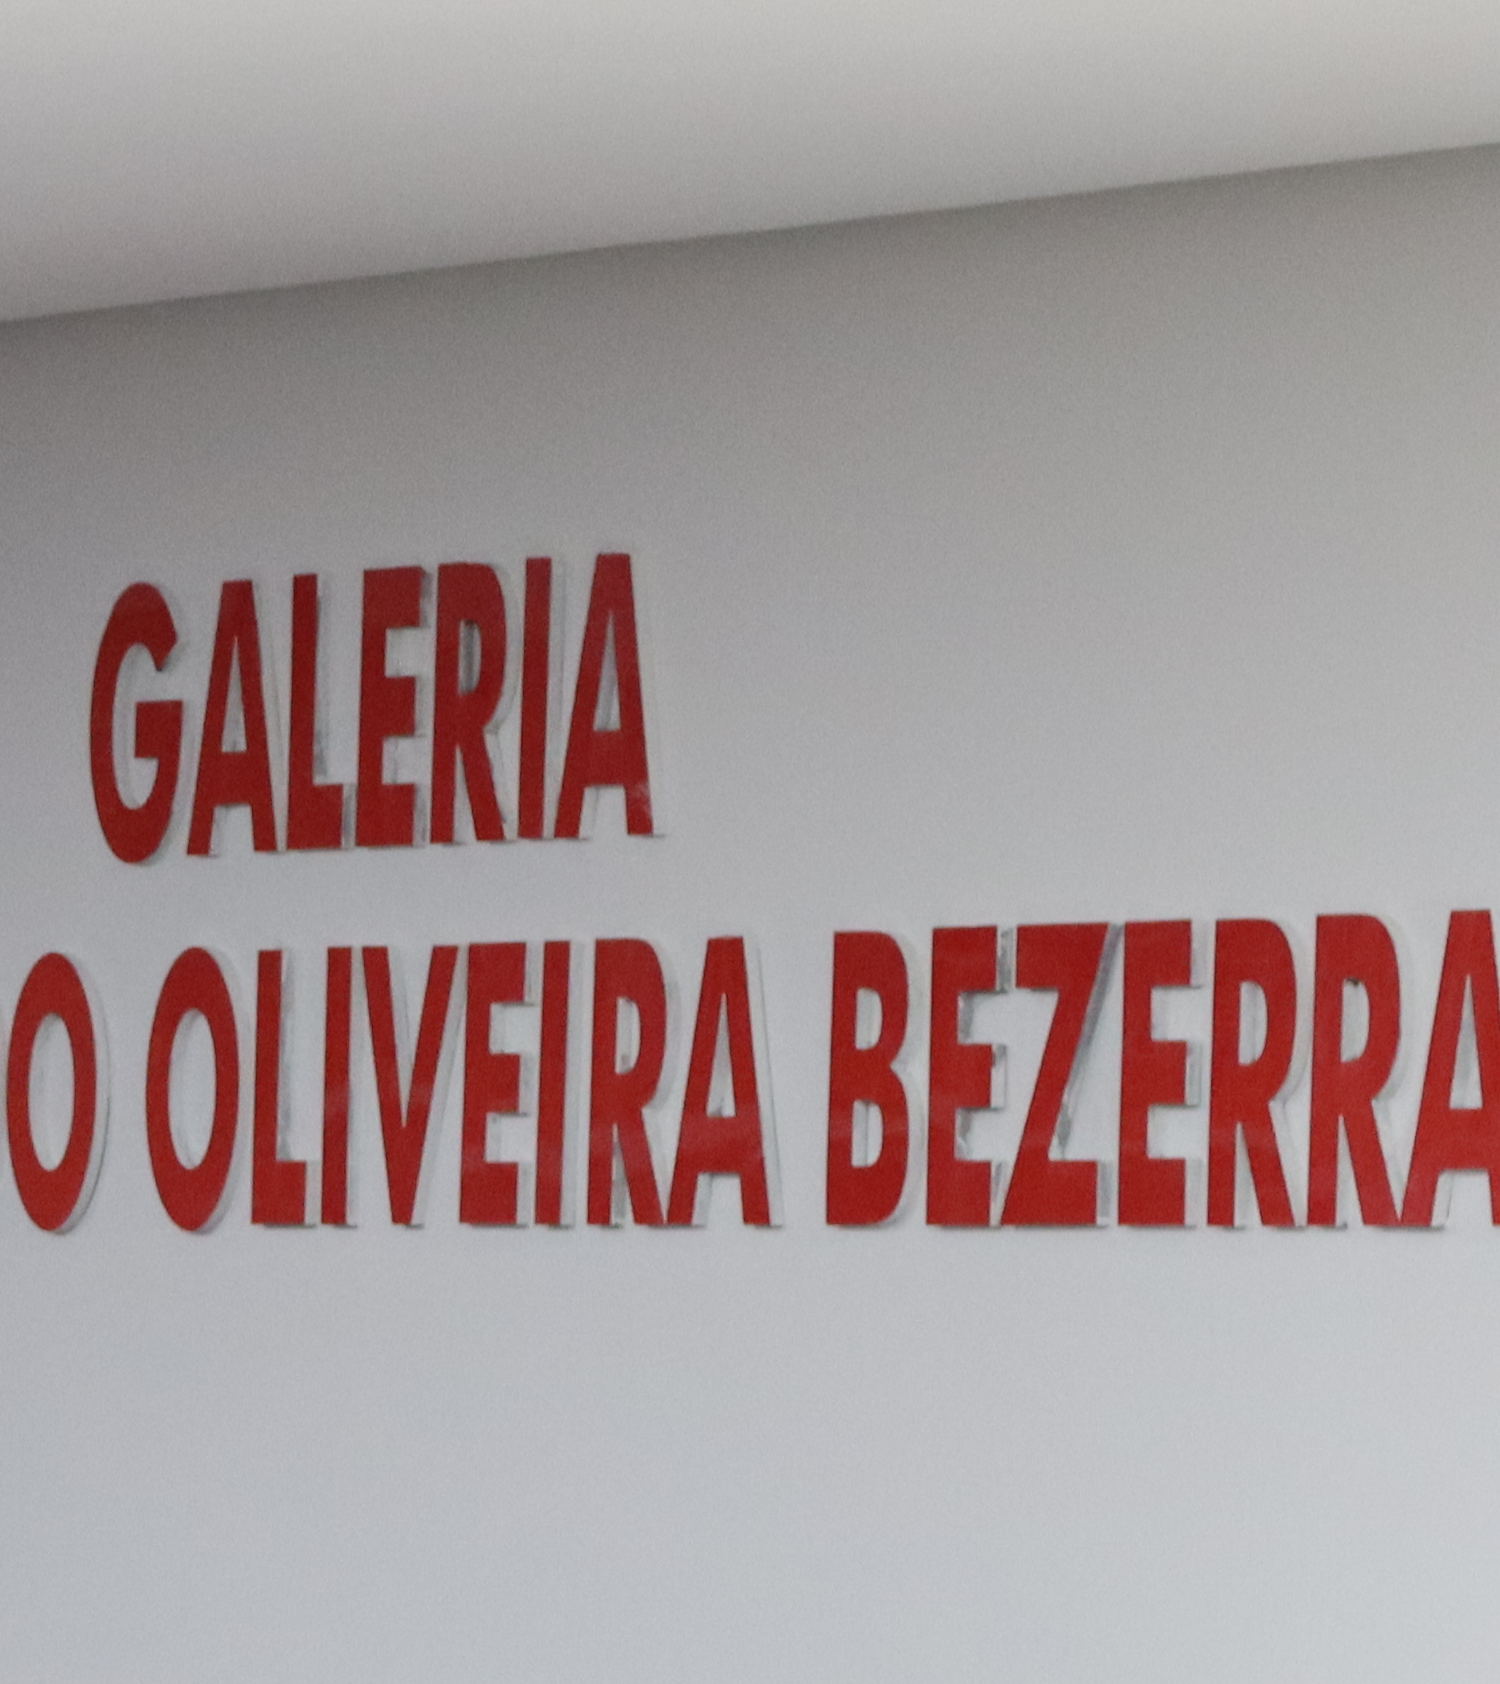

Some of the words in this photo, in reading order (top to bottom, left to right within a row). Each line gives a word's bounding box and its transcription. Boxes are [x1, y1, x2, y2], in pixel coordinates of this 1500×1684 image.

[89, 552, 655, 863] GALERIA
[145, 936, 770, 1231] OLIVEIRA
[826, 909, 1500, 1228] BEZERRA
